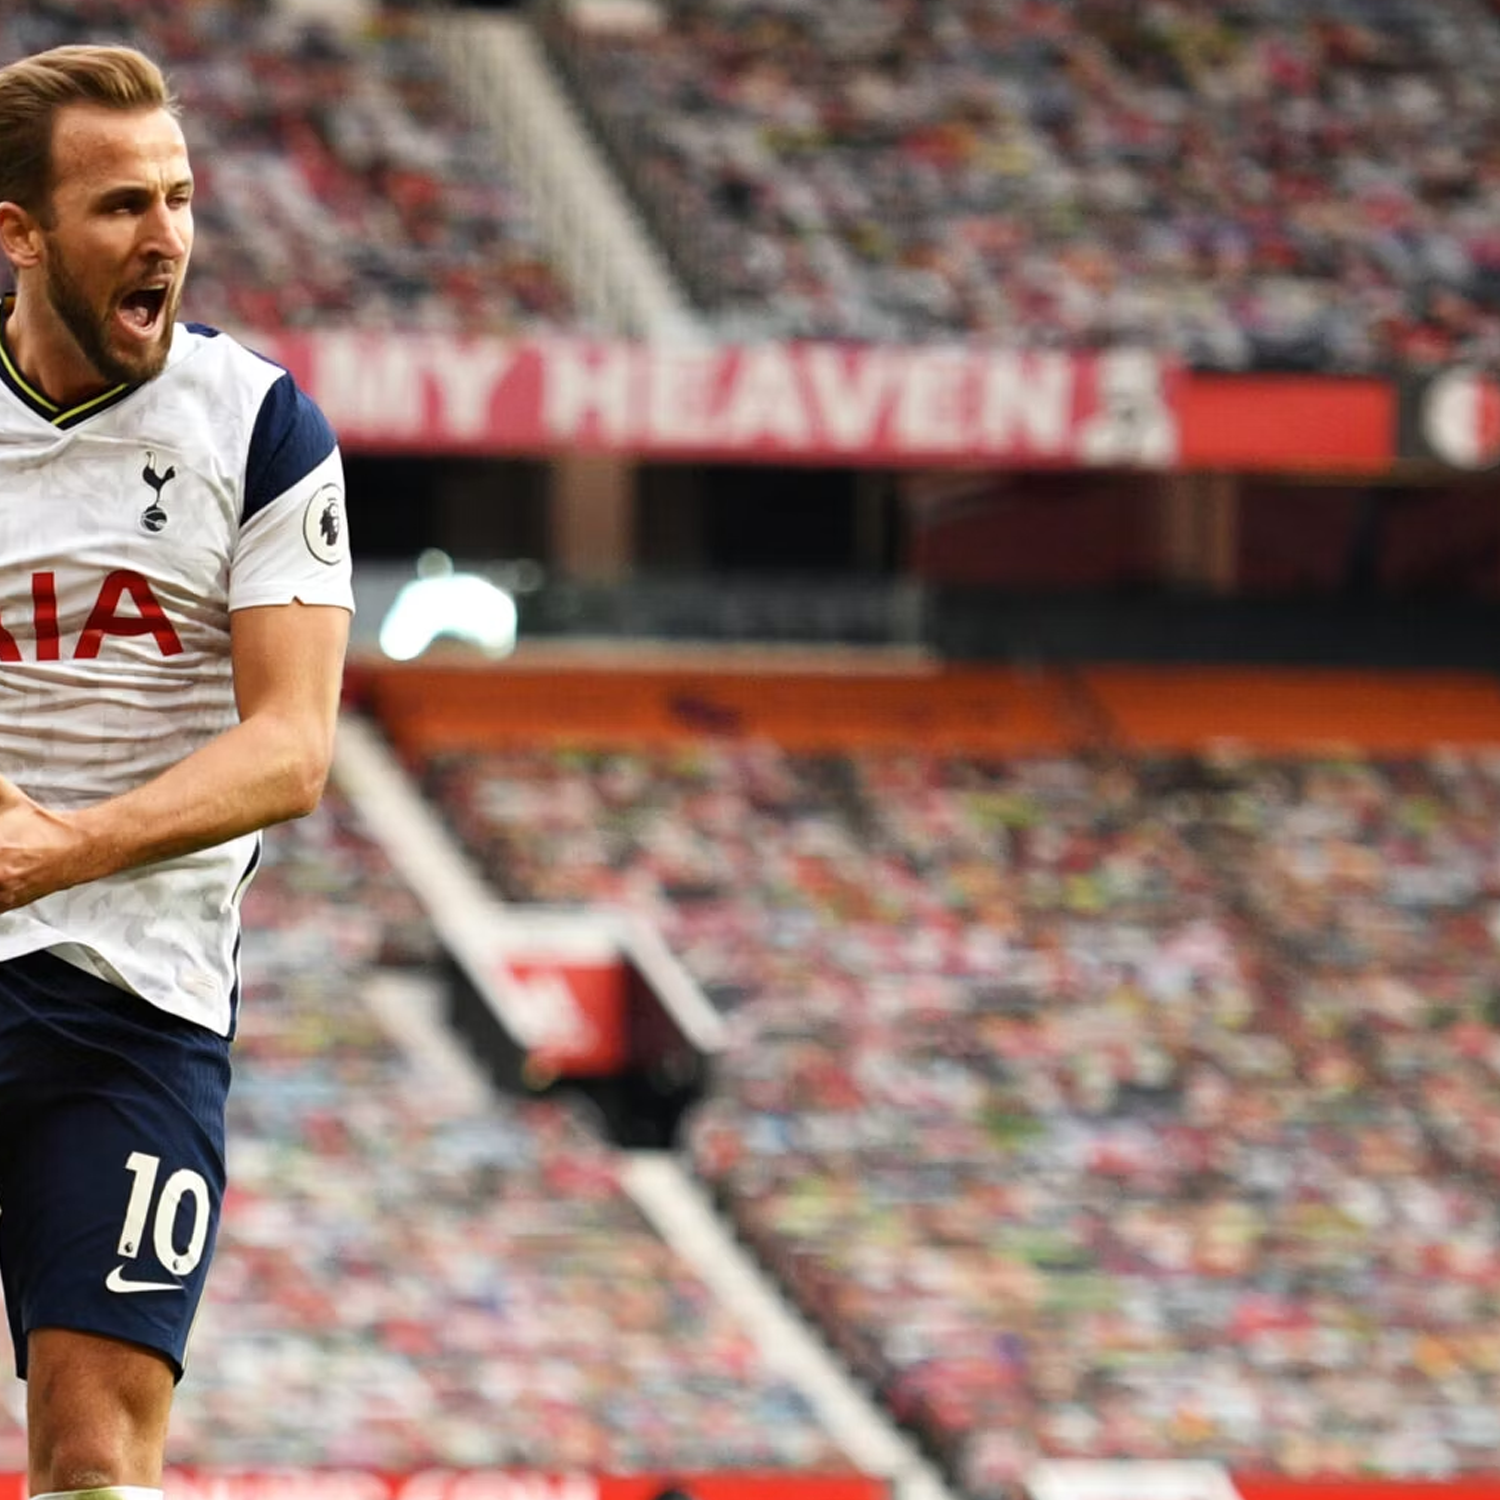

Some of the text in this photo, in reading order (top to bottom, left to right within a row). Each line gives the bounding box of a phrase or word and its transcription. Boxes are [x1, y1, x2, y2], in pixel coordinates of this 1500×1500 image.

[314, 334, 503, 438] MY
[543, 338, 1073, 454] HEAVEN
[118, 1152, 210, 1276] 10
